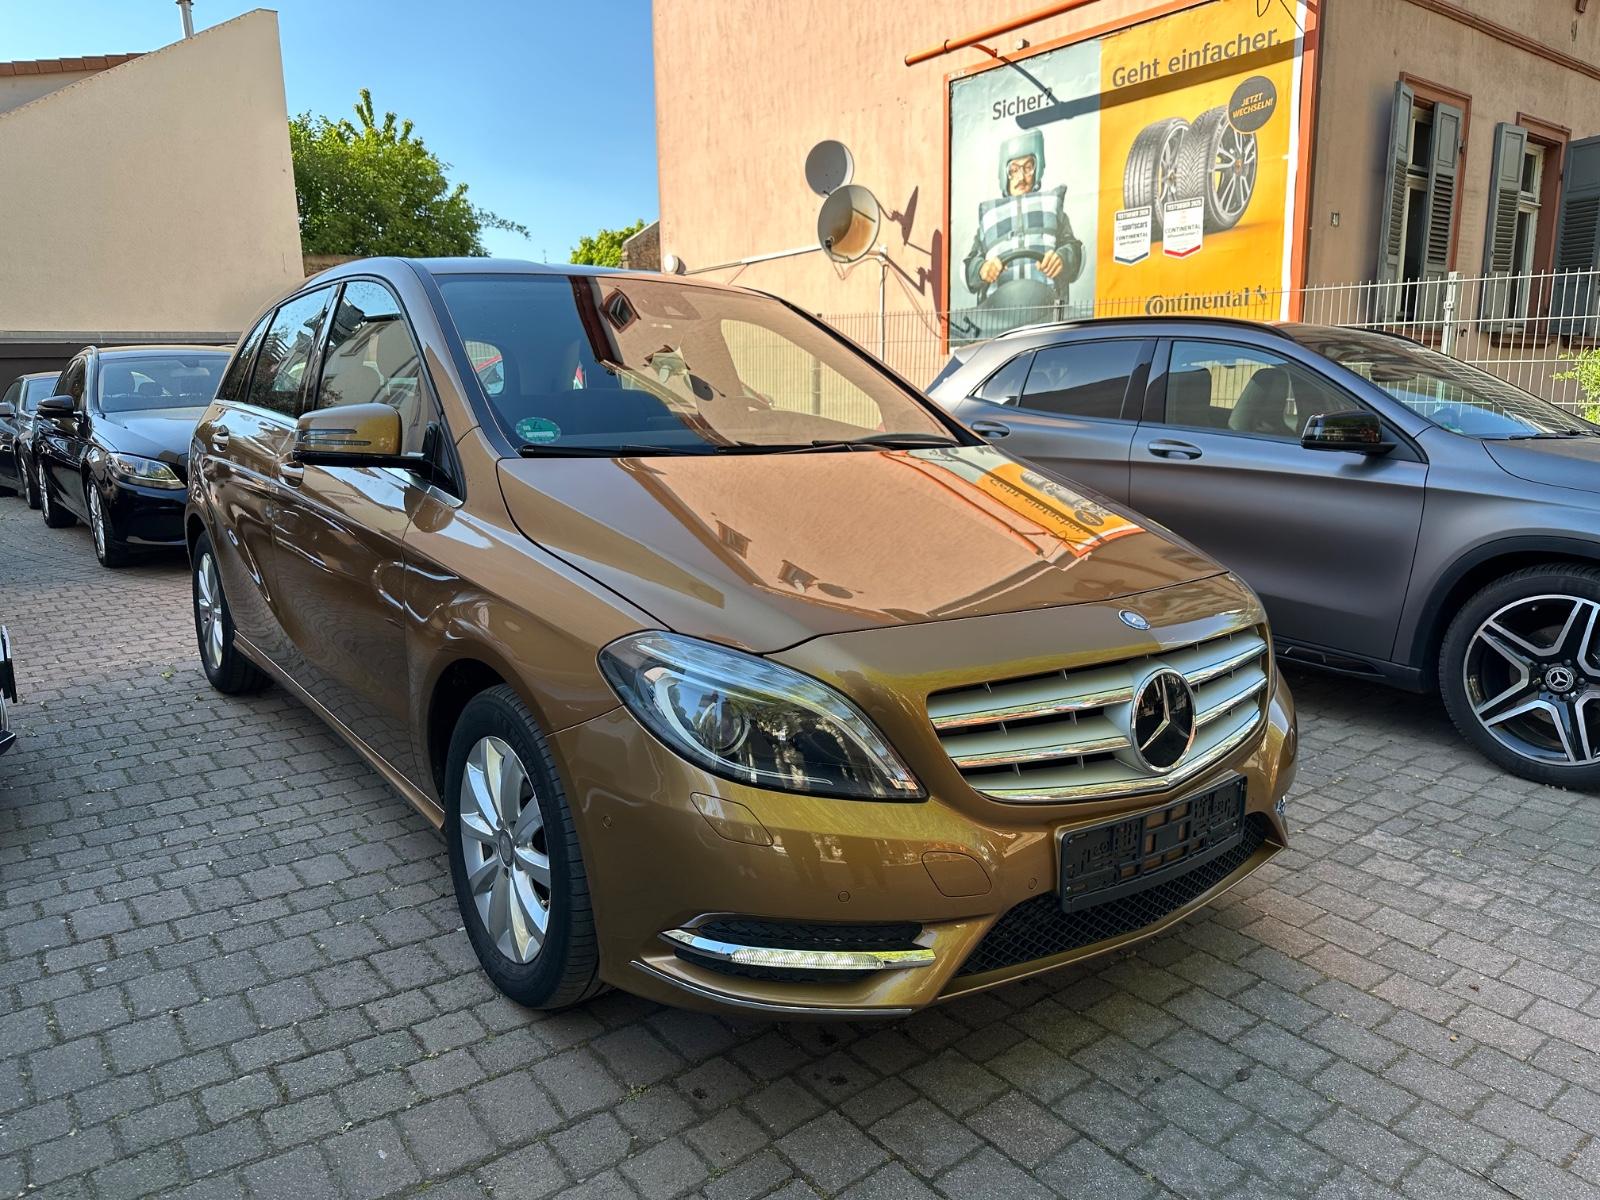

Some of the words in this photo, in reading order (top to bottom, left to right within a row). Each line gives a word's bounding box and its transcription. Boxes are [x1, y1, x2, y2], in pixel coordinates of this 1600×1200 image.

[1112, 58, 1160, 88] Geht
[1168, 28, 1281, 73] einfacher.
[992, 87, 1053, 120] Sicher?
[1232, 97, 1273, 119] WECHSELN!
[1241, 92, 1263, 107] JETZT
[1116, 232, 1148, 241] CONTINENTAL
[1165, 223, 1201, 234] CONTINENTAL
[1145, 287, 1250, 316] Continental
